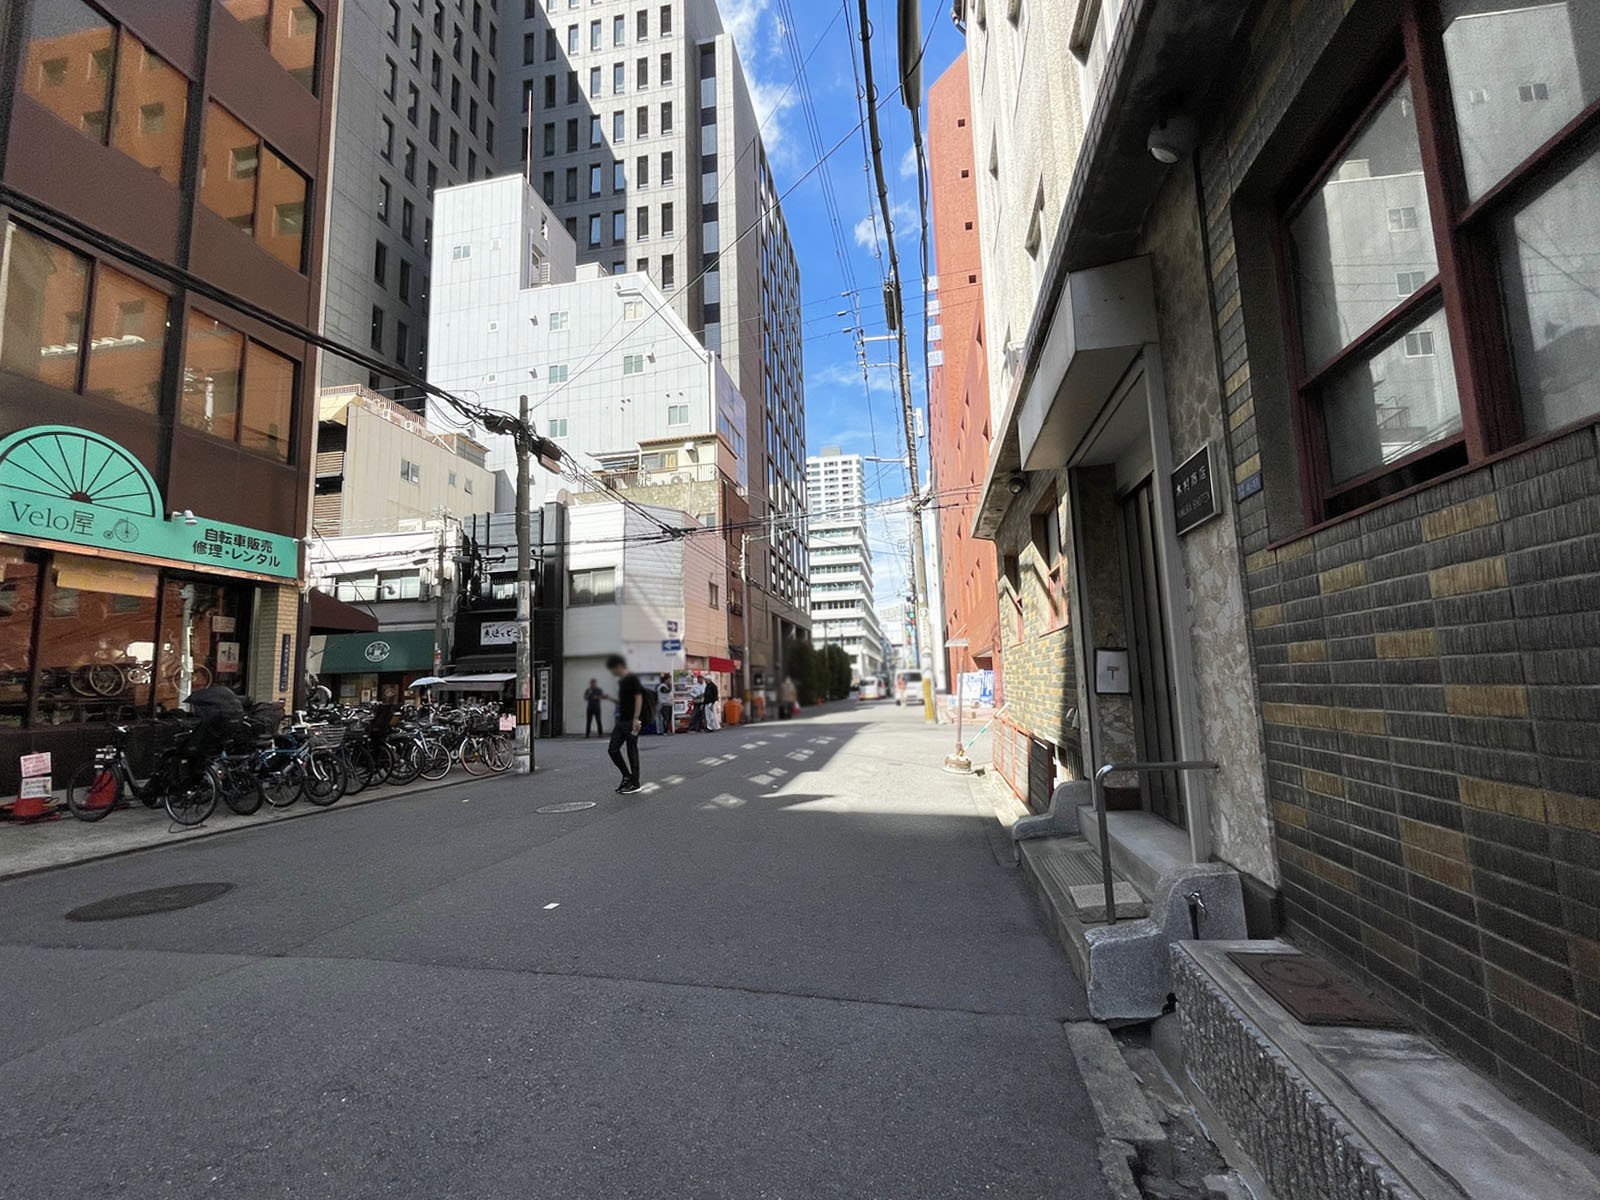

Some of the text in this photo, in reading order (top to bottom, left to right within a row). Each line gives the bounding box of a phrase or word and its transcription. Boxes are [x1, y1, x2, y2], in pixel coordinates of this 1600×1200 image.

[9, 501, 95, 536] Velo屋
[193, 540, 281, 567] 修理・レンタル
[205, 528, 273, 553] 自転車販売
